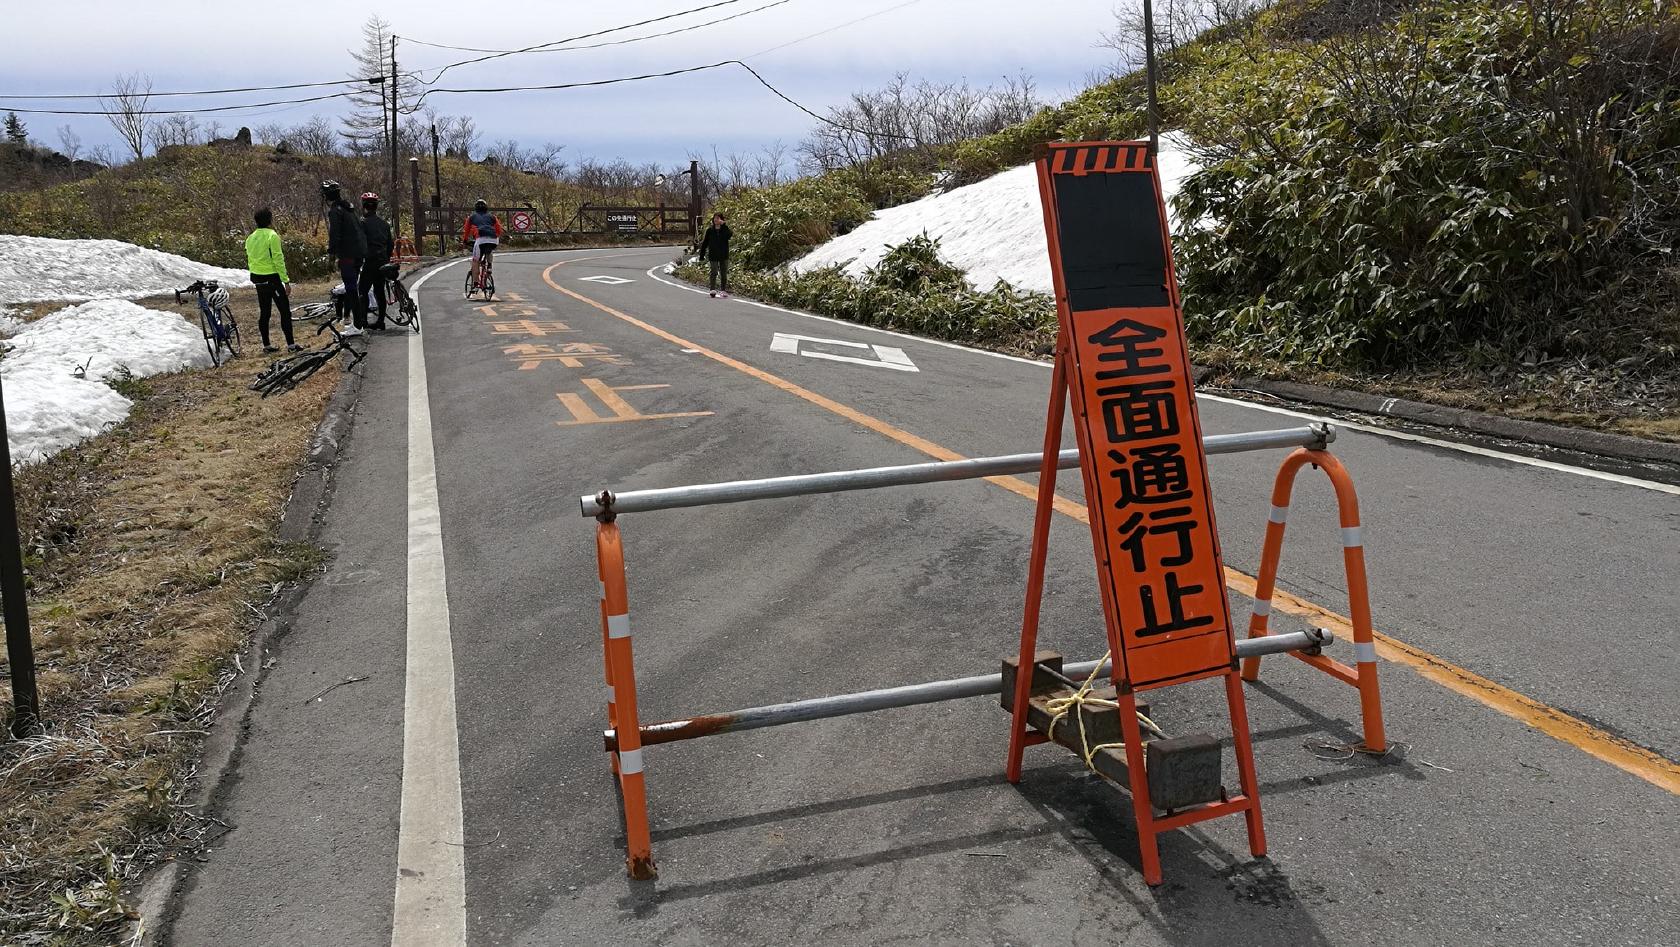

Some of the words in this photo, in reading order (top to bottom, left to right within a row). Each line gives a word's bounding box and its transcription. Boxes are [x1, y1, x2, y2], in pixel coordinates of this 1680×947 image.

[1088, 318, 1214, 638] 全面通行止
